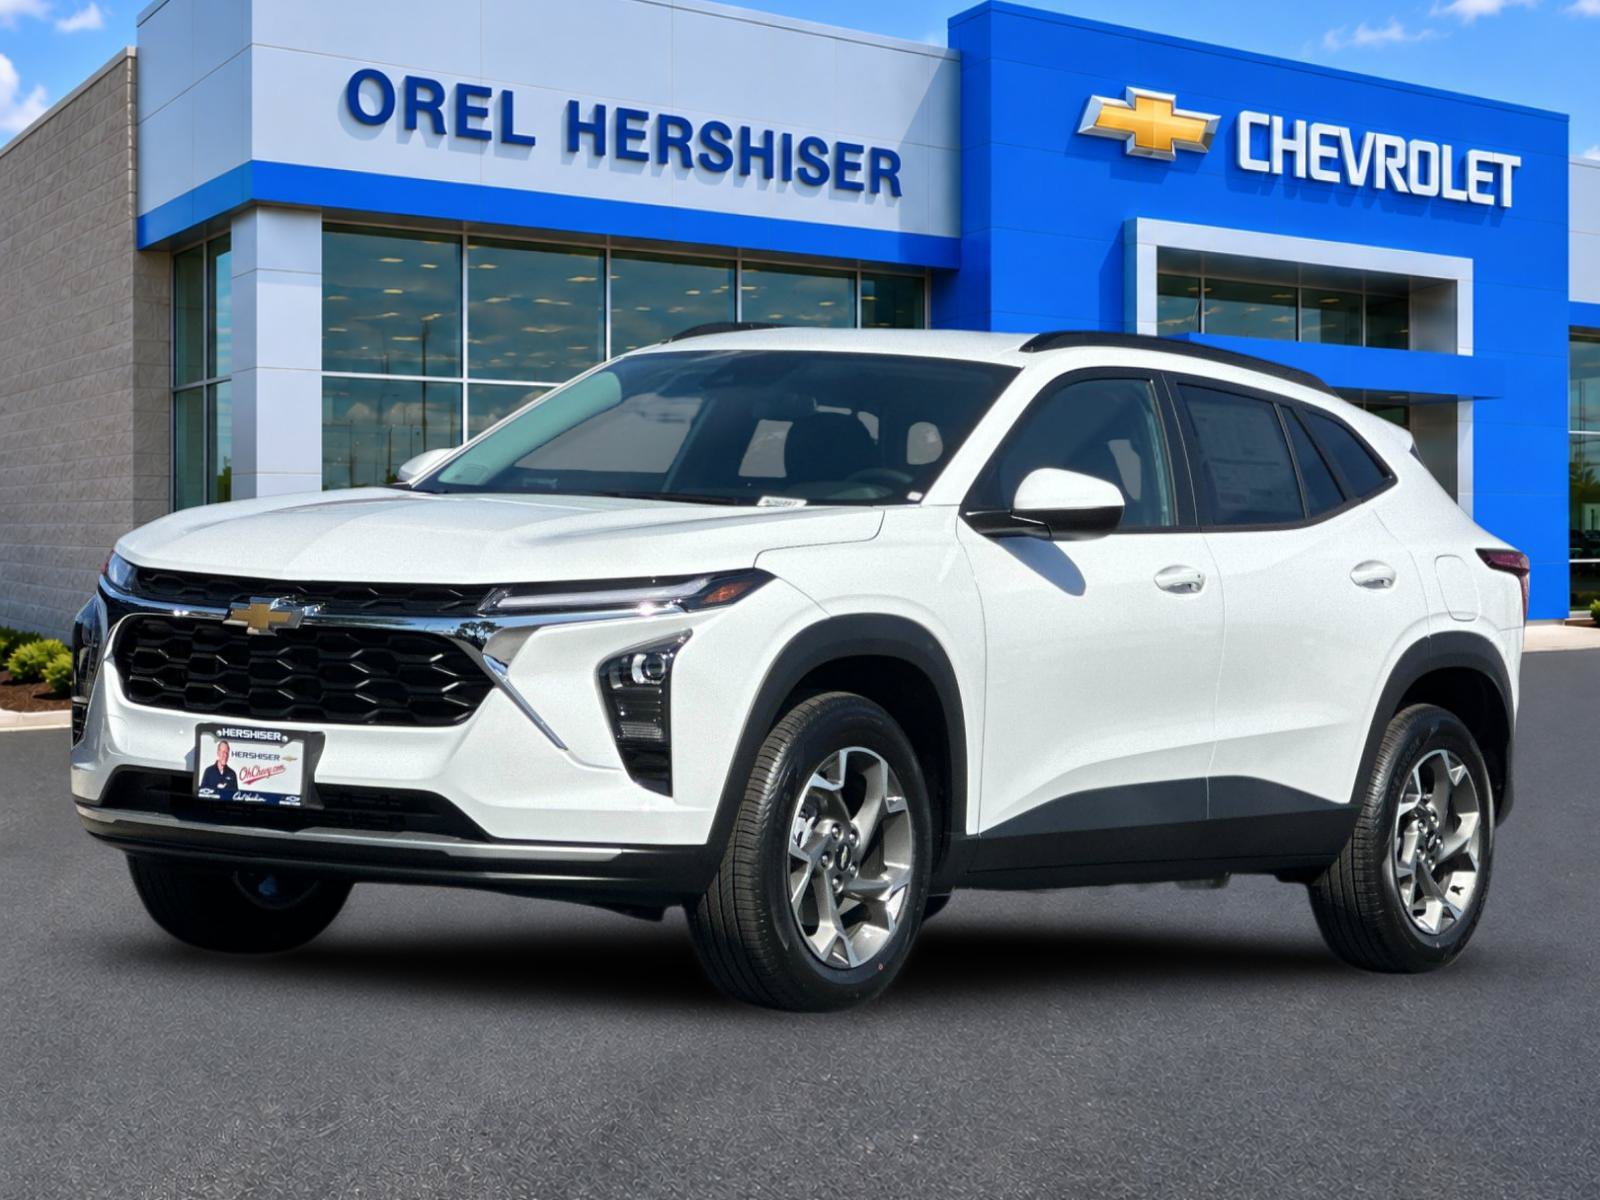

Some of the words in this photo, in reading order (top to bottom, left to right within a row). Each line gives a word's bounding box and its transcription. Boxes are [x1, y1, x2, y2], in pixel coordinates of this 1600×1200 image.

[346, 69, 535, 147] OREL
[567, 99, 902, 197] HERSHISER
[1238, 110, 1522, 208] CHEVROLET
[223, 728, 281, 741] HERSHISER
[231, 751, 280, 761] HERSHISER
